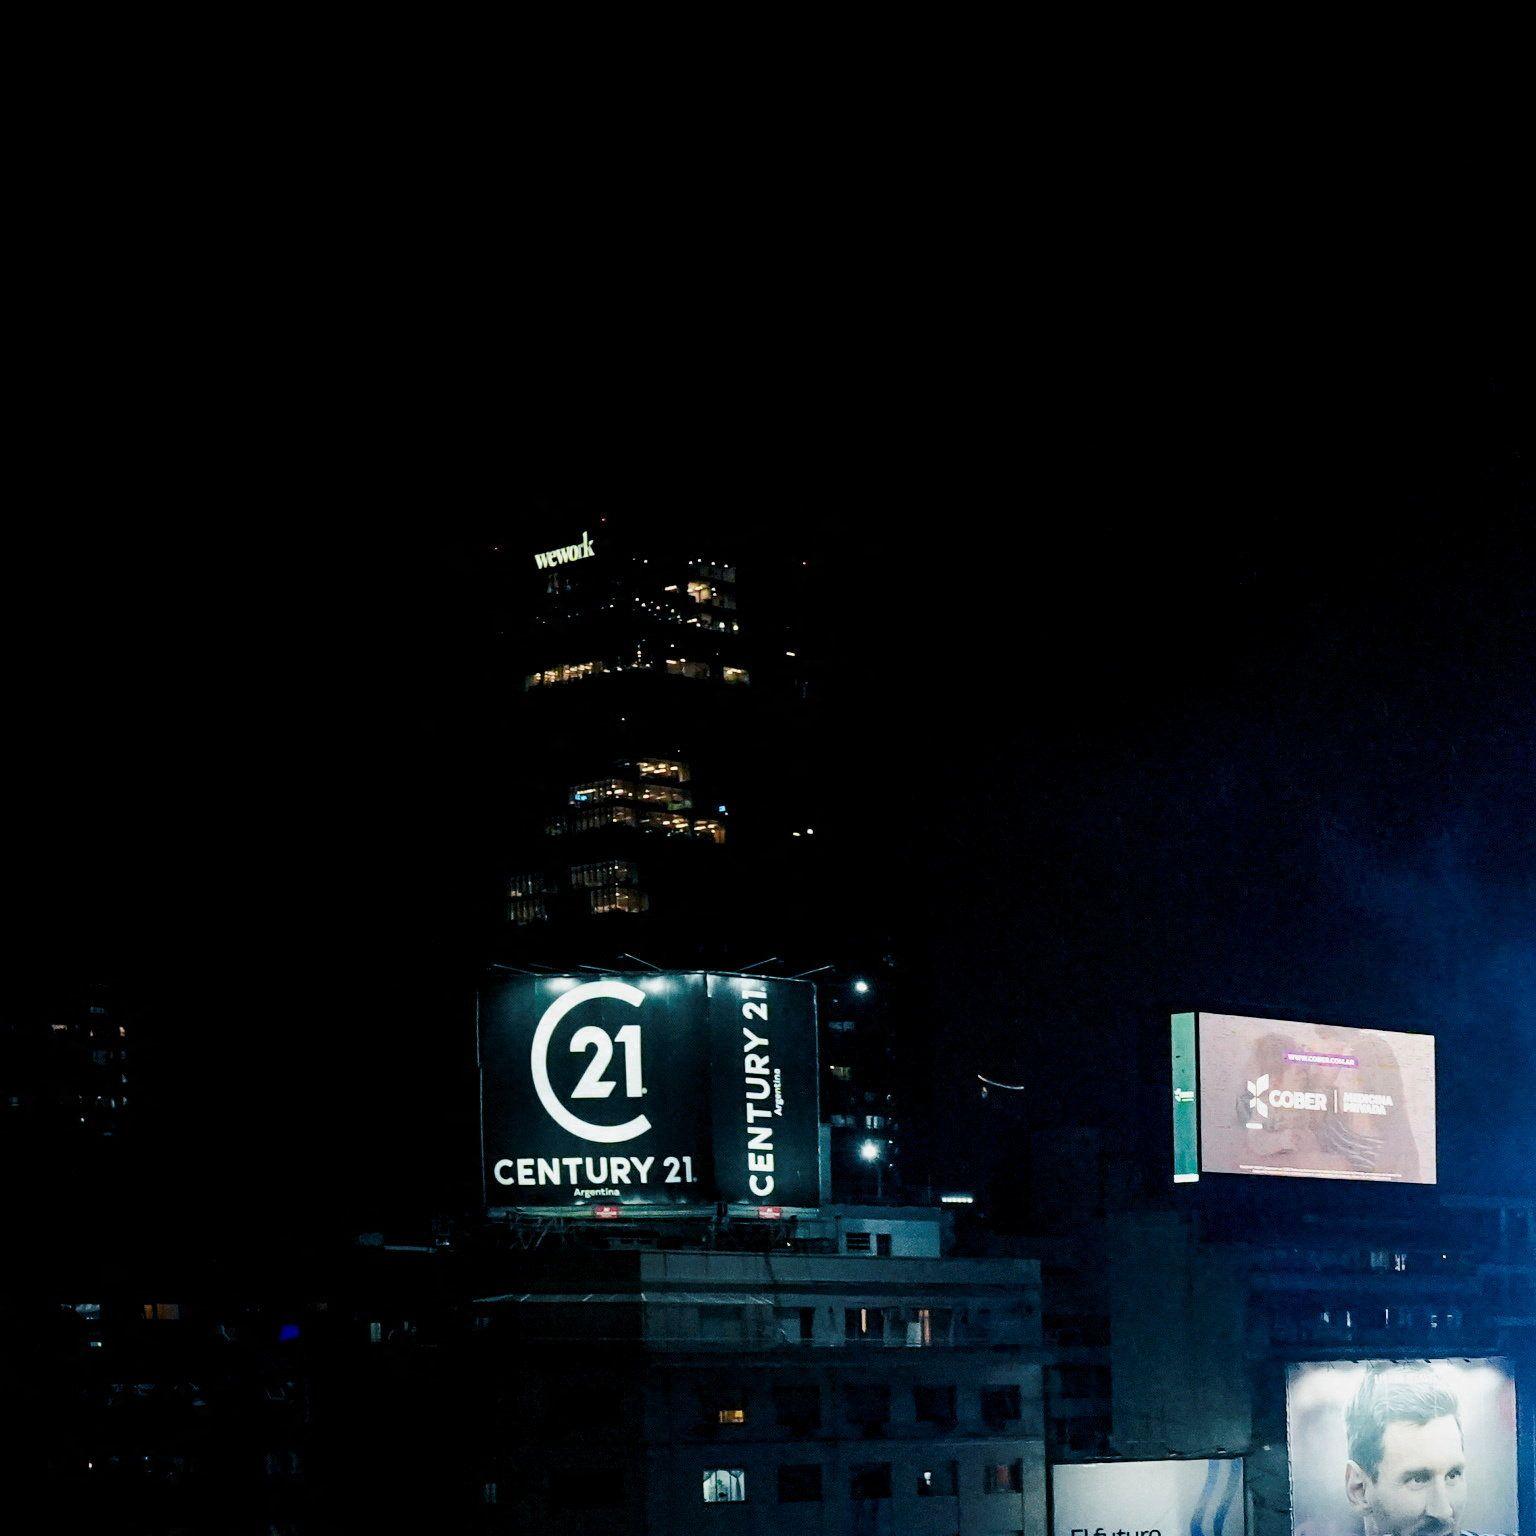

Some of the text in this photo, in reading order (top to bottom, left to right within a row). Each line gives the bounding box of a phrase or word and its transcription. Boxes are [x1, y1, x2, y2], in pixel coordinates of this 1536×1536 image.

[534, 531, 595, 569] wework
[743, 1027, 775, 1197] CENTURY
[1268, 1089, 1328, 1112] COBER
[494, 1157, 655, 1186] CENTURY
[574, 1187, 621, 1197] Argentina
